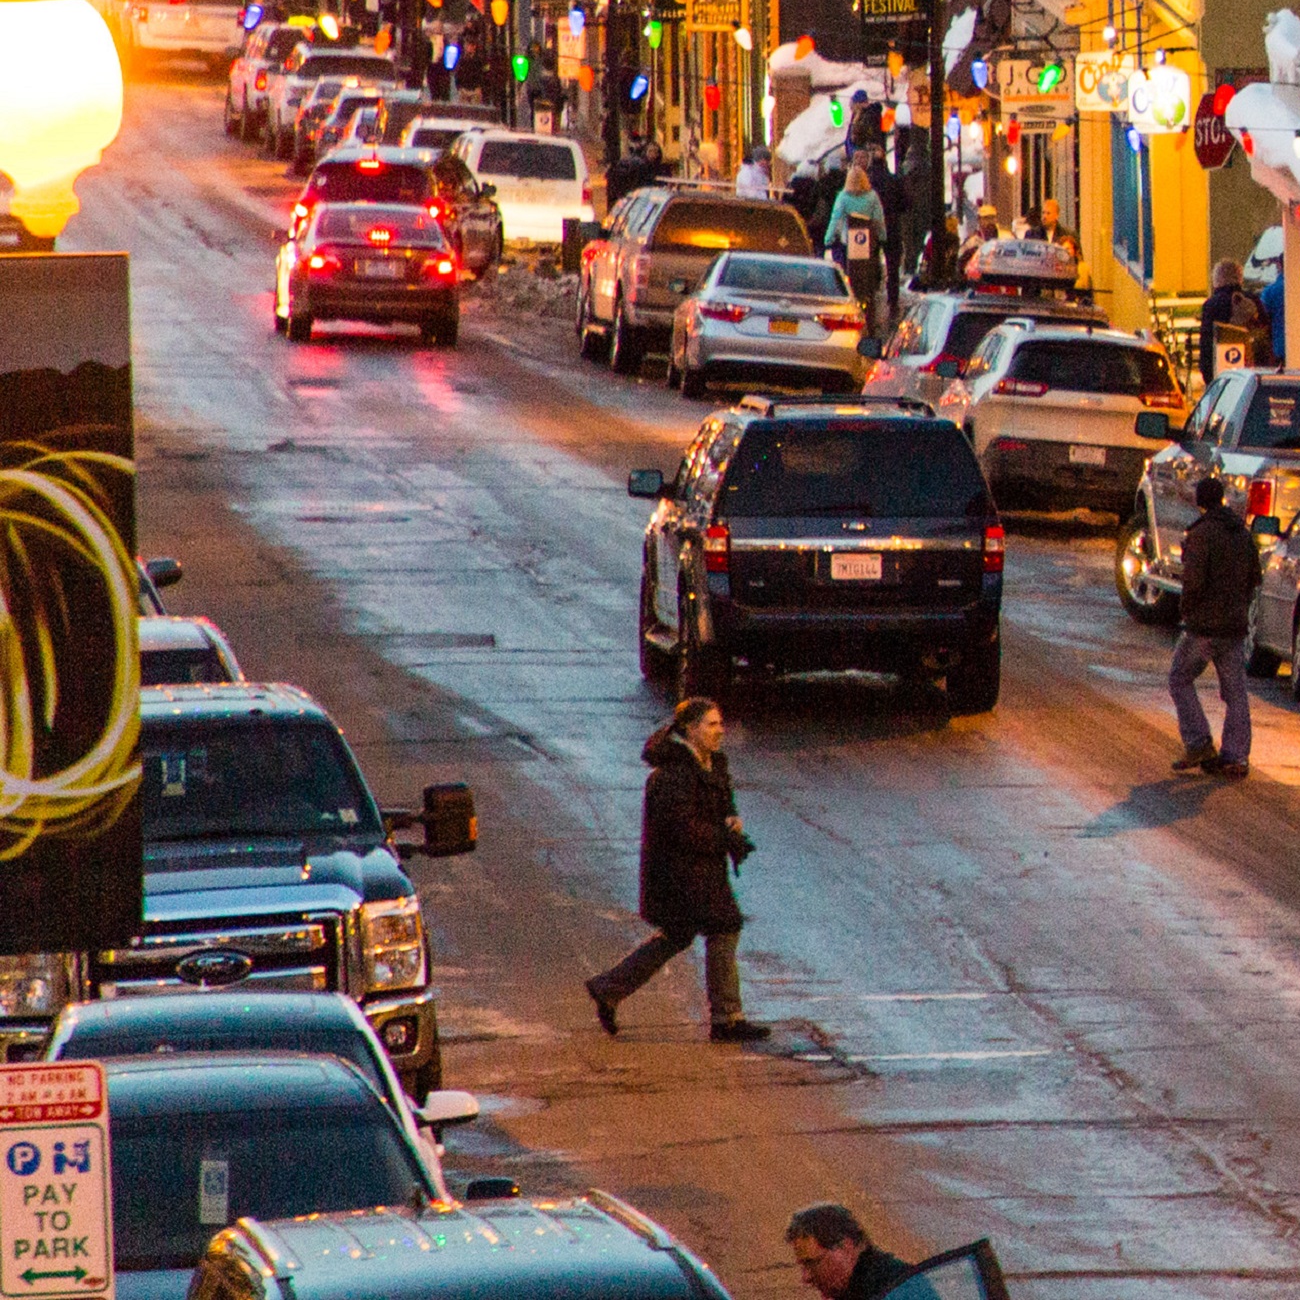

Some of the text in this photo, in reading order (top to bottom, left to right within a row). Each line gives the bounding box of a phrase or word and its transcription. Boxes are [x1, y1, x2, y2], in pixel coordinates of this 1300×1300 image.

[1196, 116, 1226, 147] STO
[8, 1071, 85, 1086] NO PARKING
[23, 1182, 78, 1205] PAY
[34, 1210, 71, 1232] TO
[14, 1236, 90, 1259] PARK
